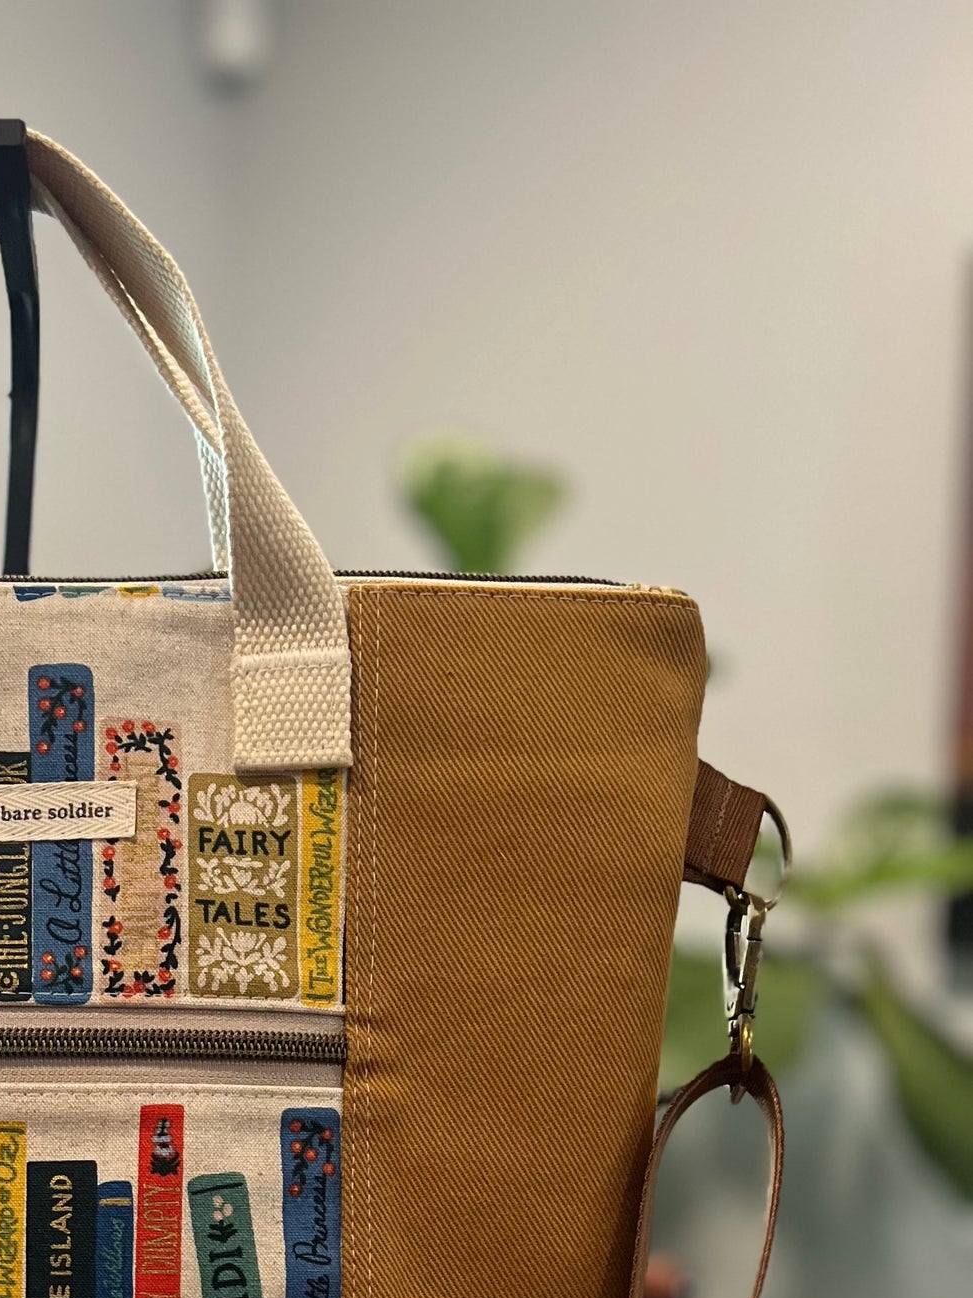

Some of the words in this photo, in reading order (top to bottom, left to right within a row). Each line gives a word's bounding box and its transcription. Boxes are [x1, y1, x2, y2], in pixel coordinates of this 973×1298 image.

[48, 801, 114, 820] soldier
[199, 827, 291, 857] FAIRY
[40, 840, 82, 913] Littl
[195, 899, 291, 929] TALES
[49, 1174, 73, 1276] ISLAND
[140, 1183, 181, 1276] DUMPTY
[292, 1175, 332, 1266] Princess
